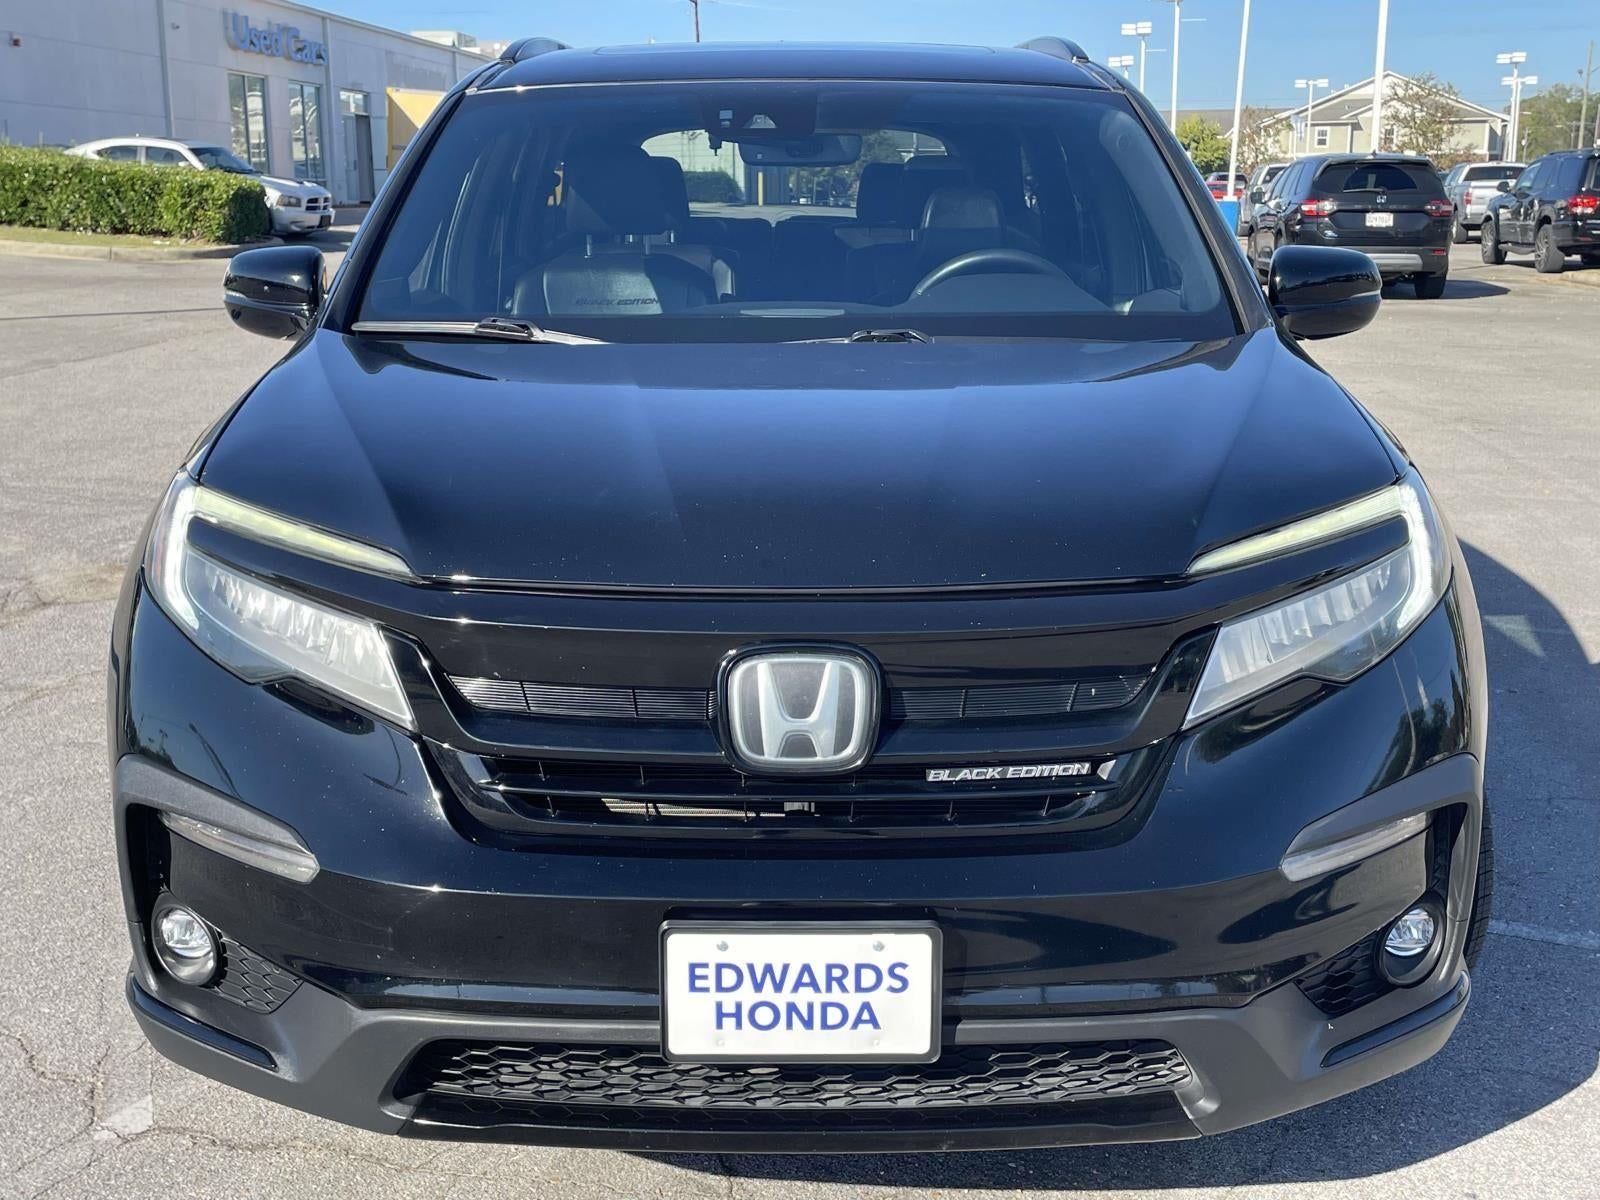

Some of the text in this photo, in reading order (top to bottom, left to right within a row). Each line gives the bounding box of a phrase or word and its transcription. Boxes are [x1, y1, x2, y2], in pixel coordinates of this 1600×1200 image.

[222, 10, 329, 65] Used Cars
[616, 297, 659, 305] EDITION
[927, 763, 1090, 782] BLACK EDITION
[687, 962, 909, 994] EDWARDS
[715, 1000, 882, 1031] HONDA
